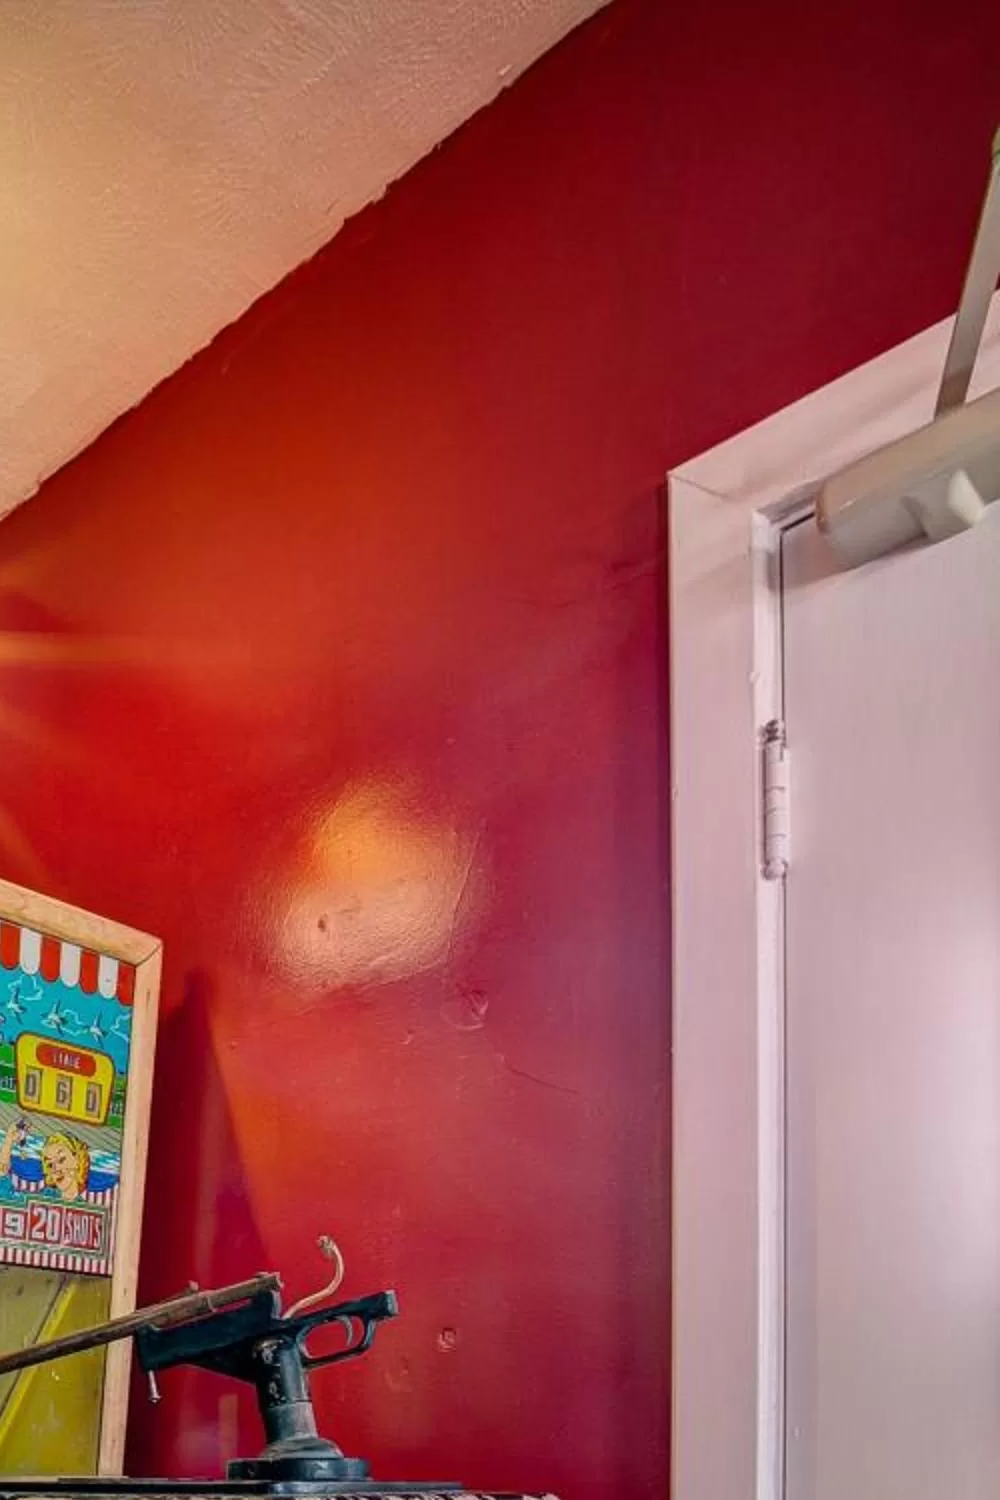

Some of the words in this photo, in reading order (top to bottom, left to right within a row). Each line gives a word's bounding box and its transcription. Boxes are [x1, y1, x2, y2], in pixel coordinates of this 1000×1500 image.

[4, 1211, 26, 1237] 9
[31, 1207, 61, 1241] 20
[63, 1211, 101, 1248] SHOTS
